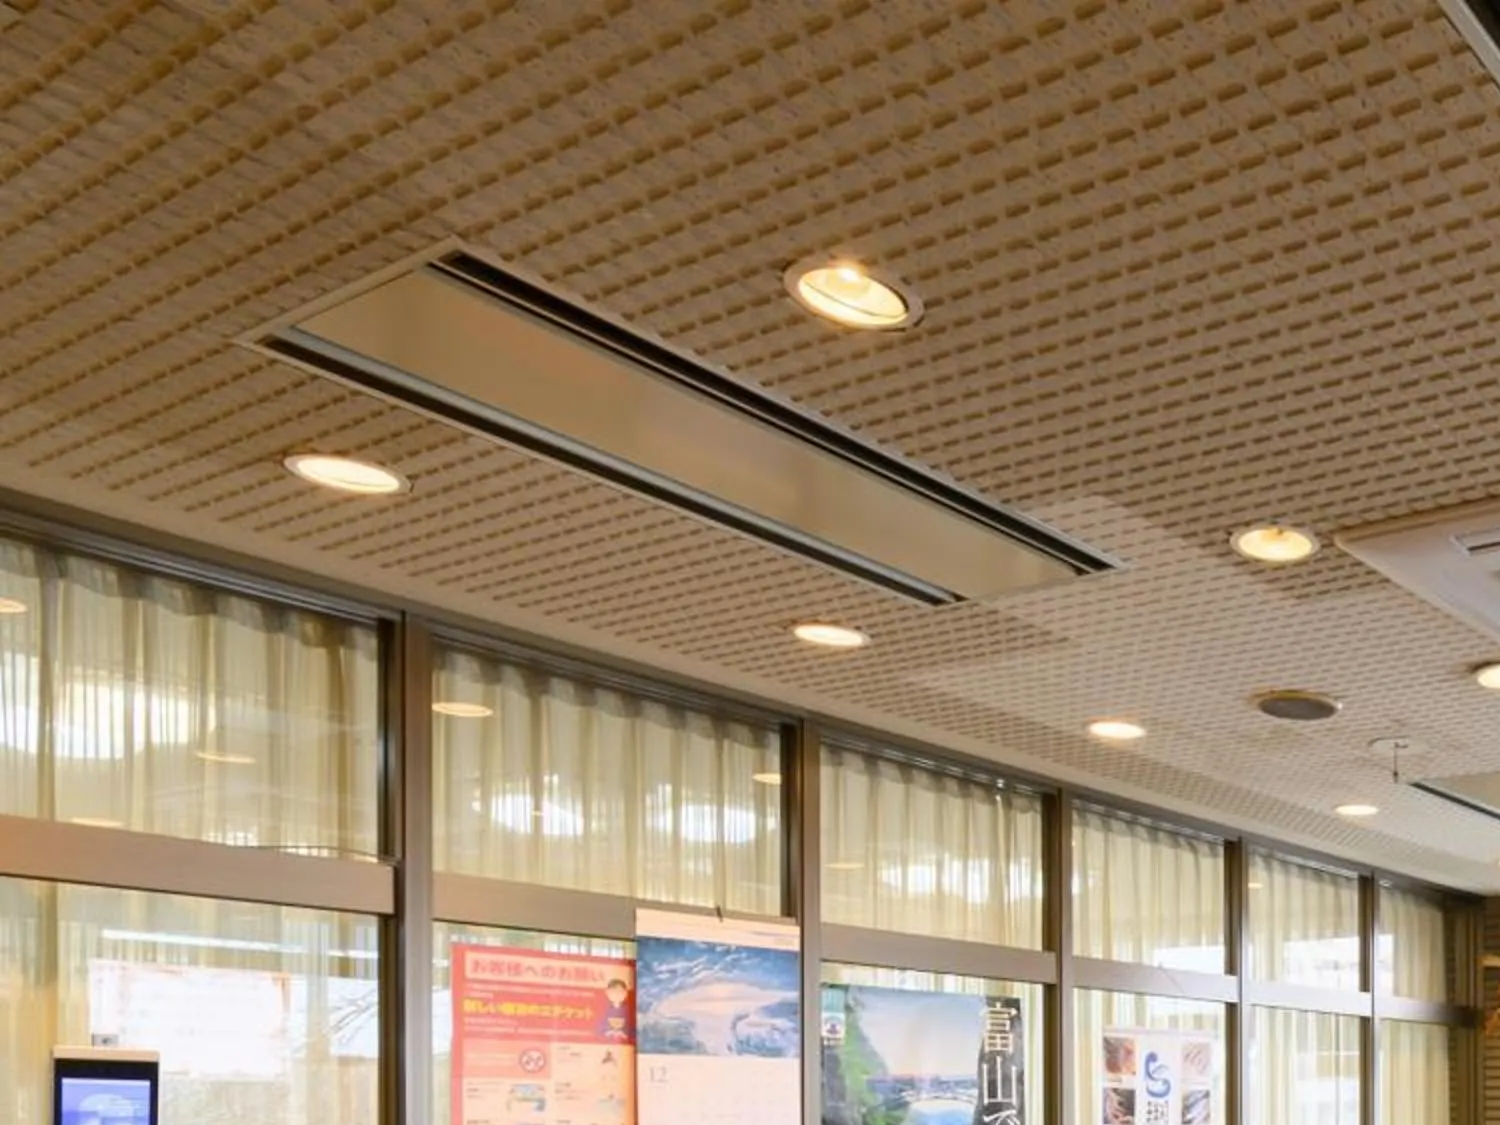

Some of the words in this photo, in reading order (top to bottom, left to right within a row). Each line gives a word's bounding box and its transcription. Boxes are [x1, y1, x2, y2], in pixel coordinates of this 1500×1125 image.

[470, 958, 607, 983] お客様へのお願い
[648, 1066, 669, 1084] 12
